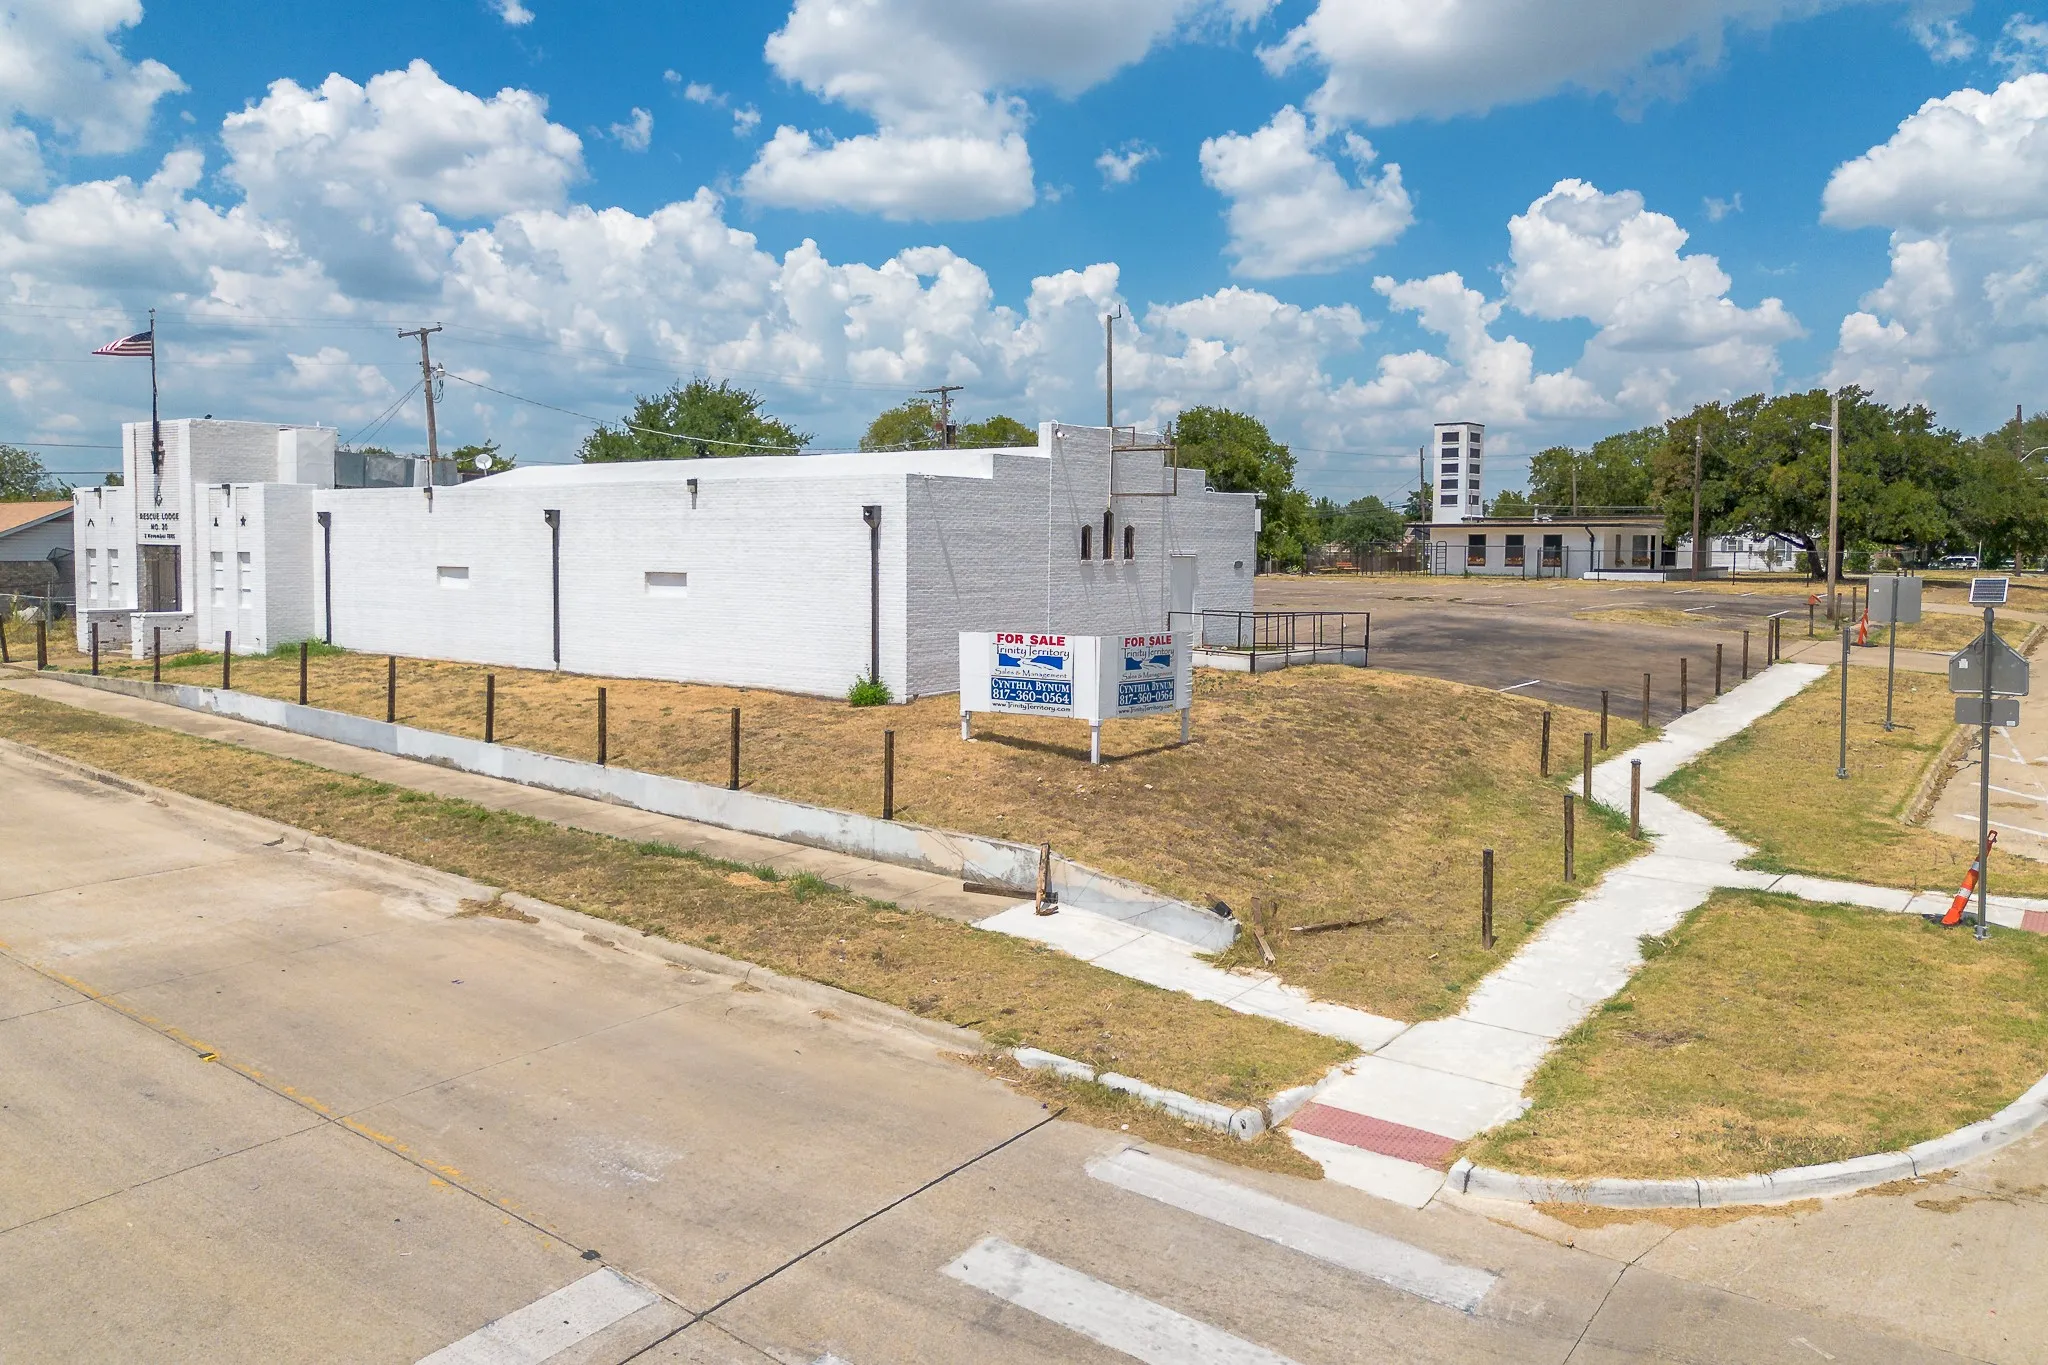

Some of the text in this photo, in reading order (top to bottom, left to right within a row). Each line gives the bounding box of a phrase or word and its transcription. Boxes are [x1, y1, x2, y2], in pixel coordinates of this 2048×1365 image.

[996, 634, 1066, 646] FOR SALE
[1124, 635, 1172, 647] FOR SALE
[1022, 670, 1067, 679] Management
[992, 678, 1069, 692] CYNTHIA BYNUM
[1120, 682, 1173, 694] CYNTHIA BYNUM
[992, 689, 1070, 704] 817-360-0564
[1120, 690, 1173, 706] 817-360-0564
[992, 702, 1070, 712] www.TrinityTerritory.com
